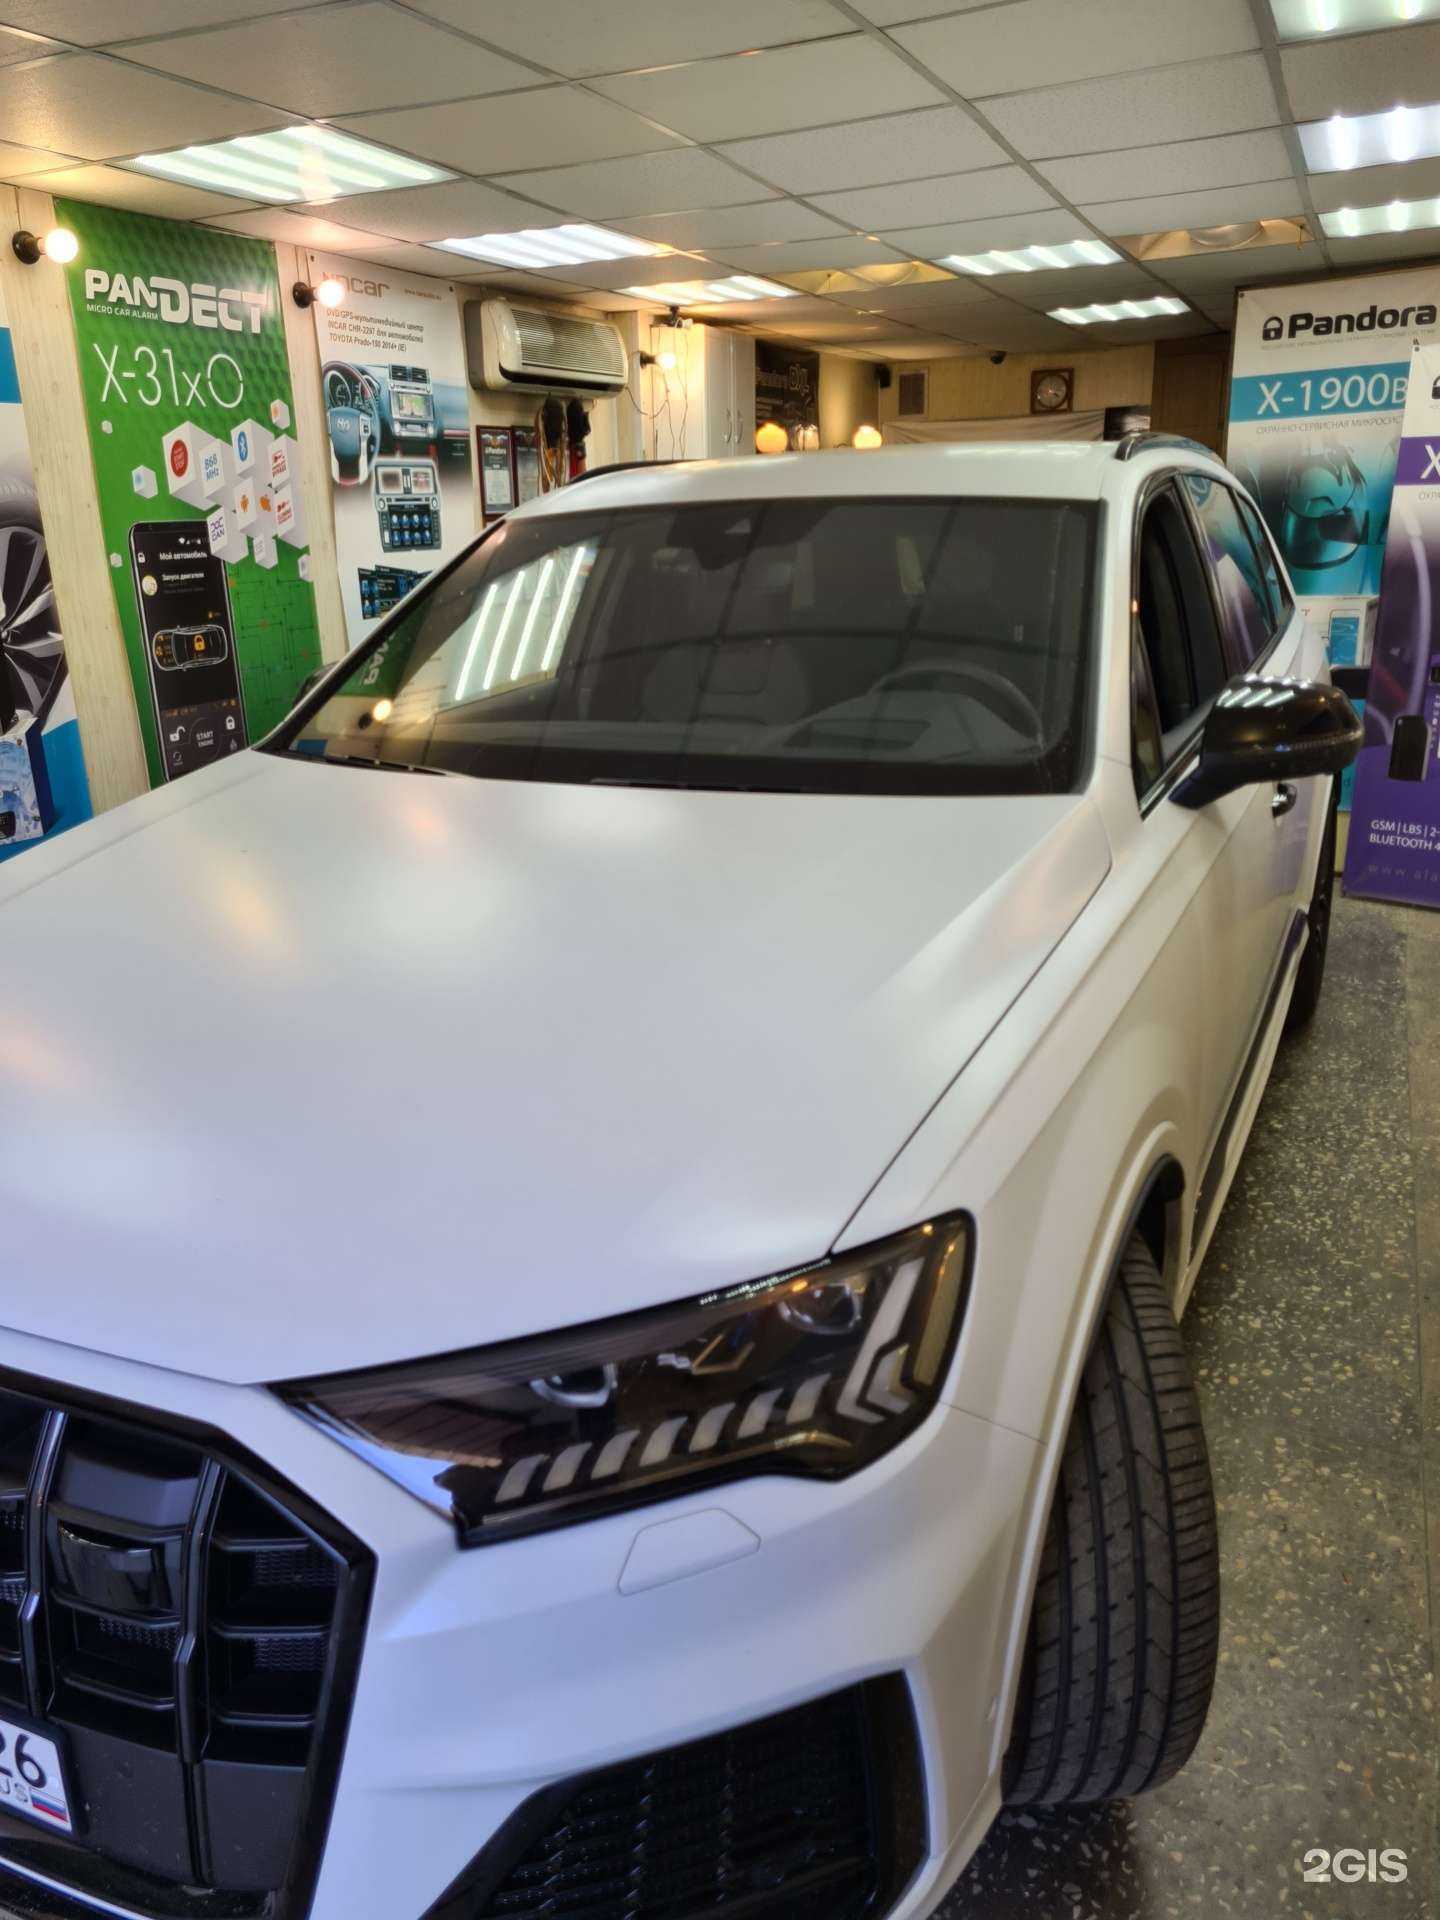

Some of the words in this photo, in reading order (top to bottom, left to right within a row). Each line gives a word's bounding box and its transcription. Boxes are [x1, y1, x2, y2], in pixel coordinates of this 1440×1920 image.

[85, 268, 269, 334] PANDECT
[86, 303, 113, 315] MICRO
[114, 307, 131, 317] CAR
[132, 310, 159, 320] ALARM
[1288, 304, 1437, 339] Pandora
[1371, 819, 1396, 832] GSM
[1403, 823, 1422, 835] LBS
[1369, 832, 1433, 851] BLUETOOTH
